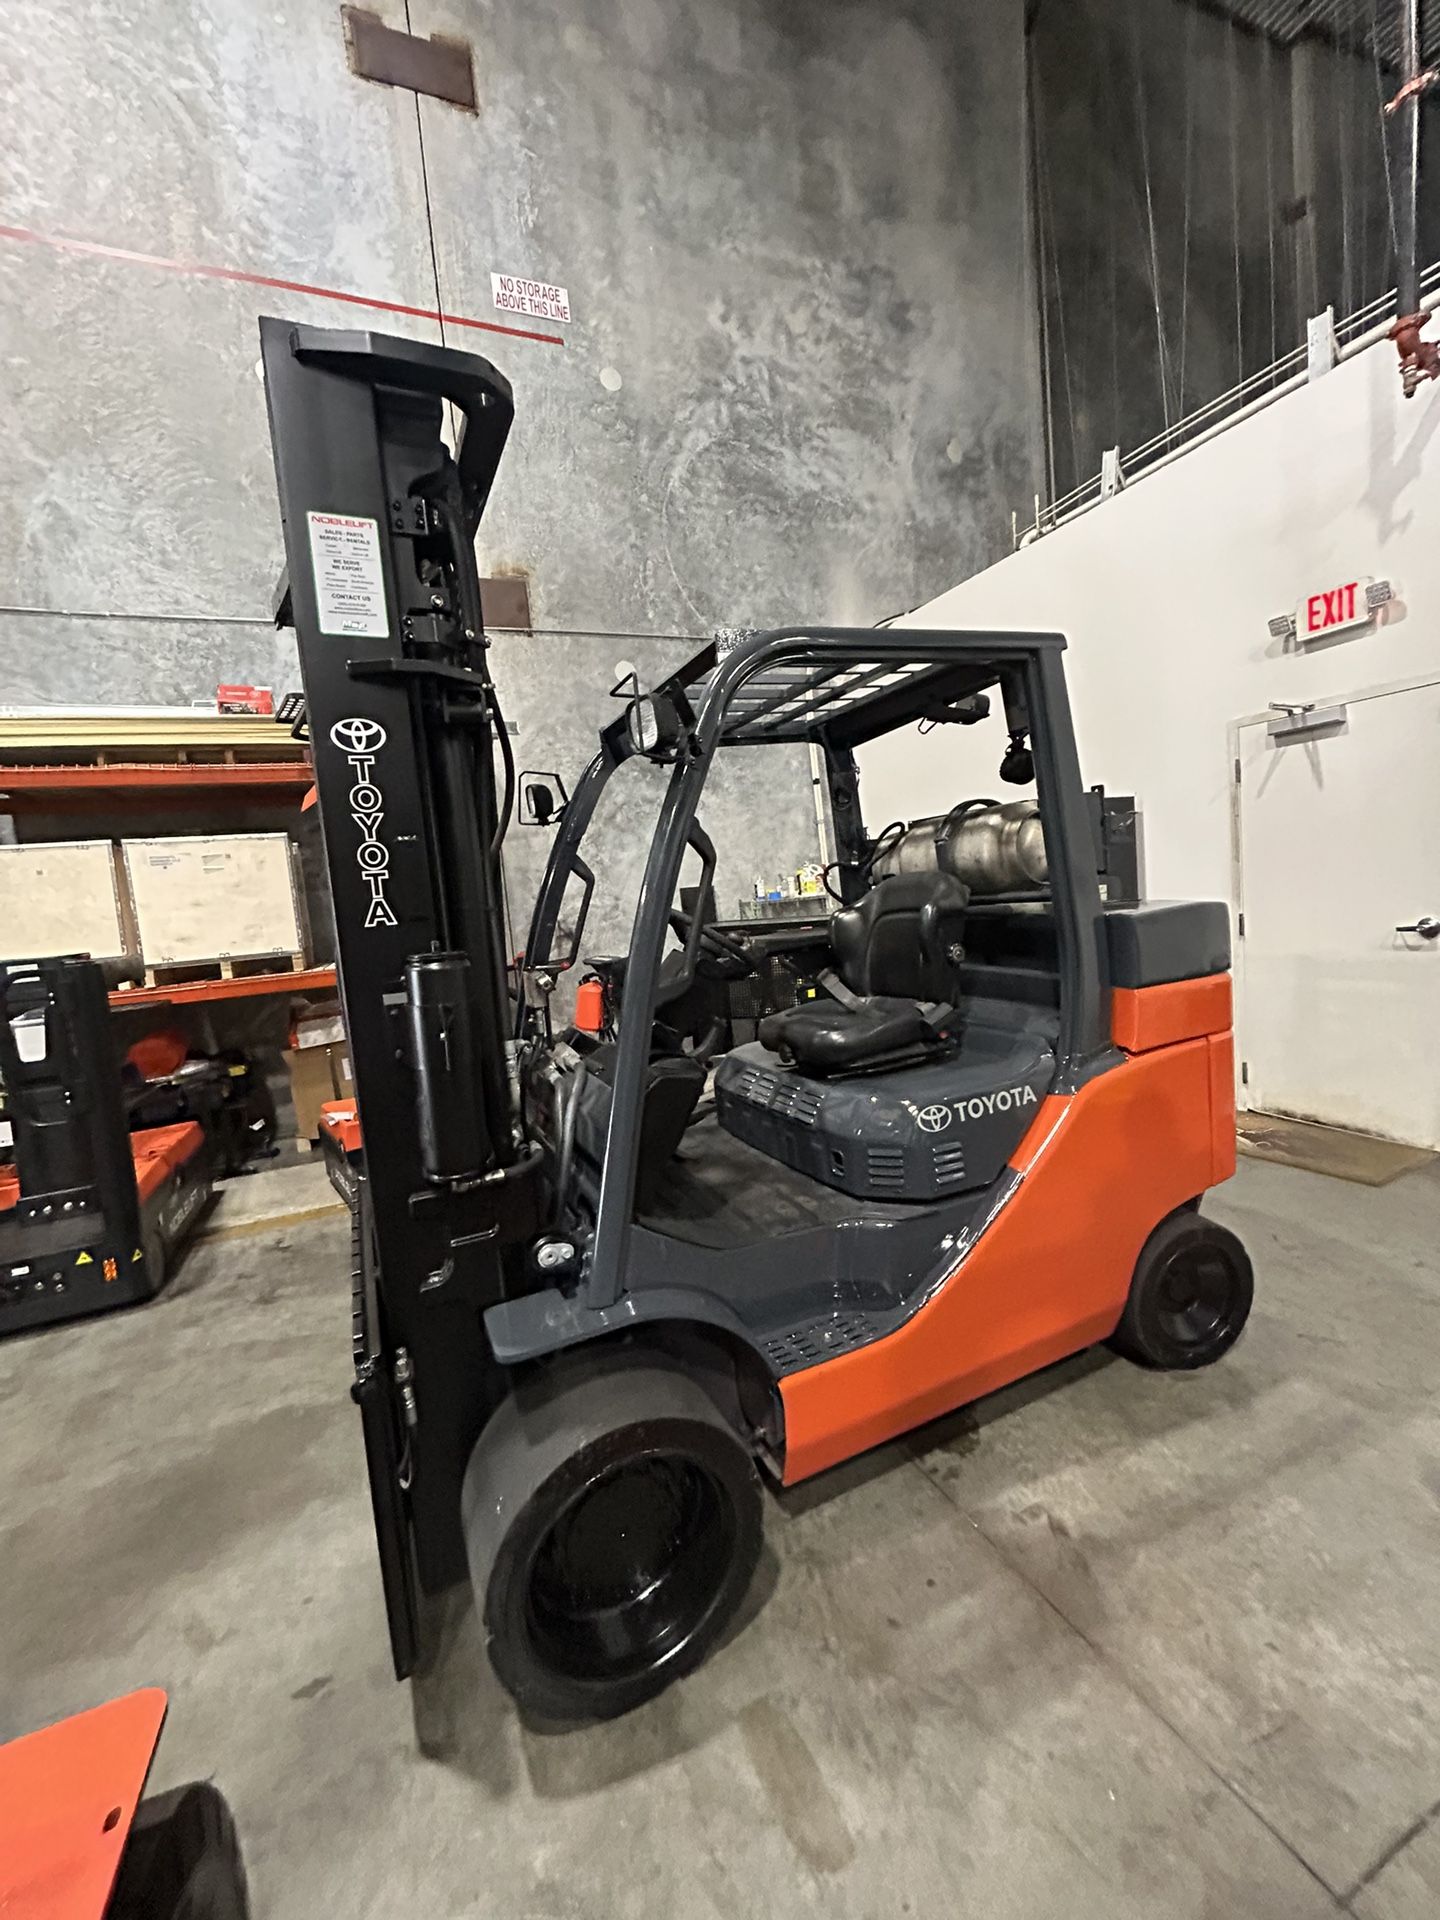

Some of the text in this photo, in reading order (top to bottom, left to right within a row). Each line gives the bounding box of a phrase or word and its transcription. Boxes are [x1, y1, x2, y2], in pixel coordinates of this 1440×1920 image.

[499, 276, 561, 303] NO STORAGE
[495, 292, 569, 320] ABOVE THIS LINE
[331, 593, 360, 601] CONTACT
[1307, 582, 1358, 632] EXIT
[347, 755, 398, 928] TOYOTA
[953, 1085, 1037, 1122] TOYOTA
